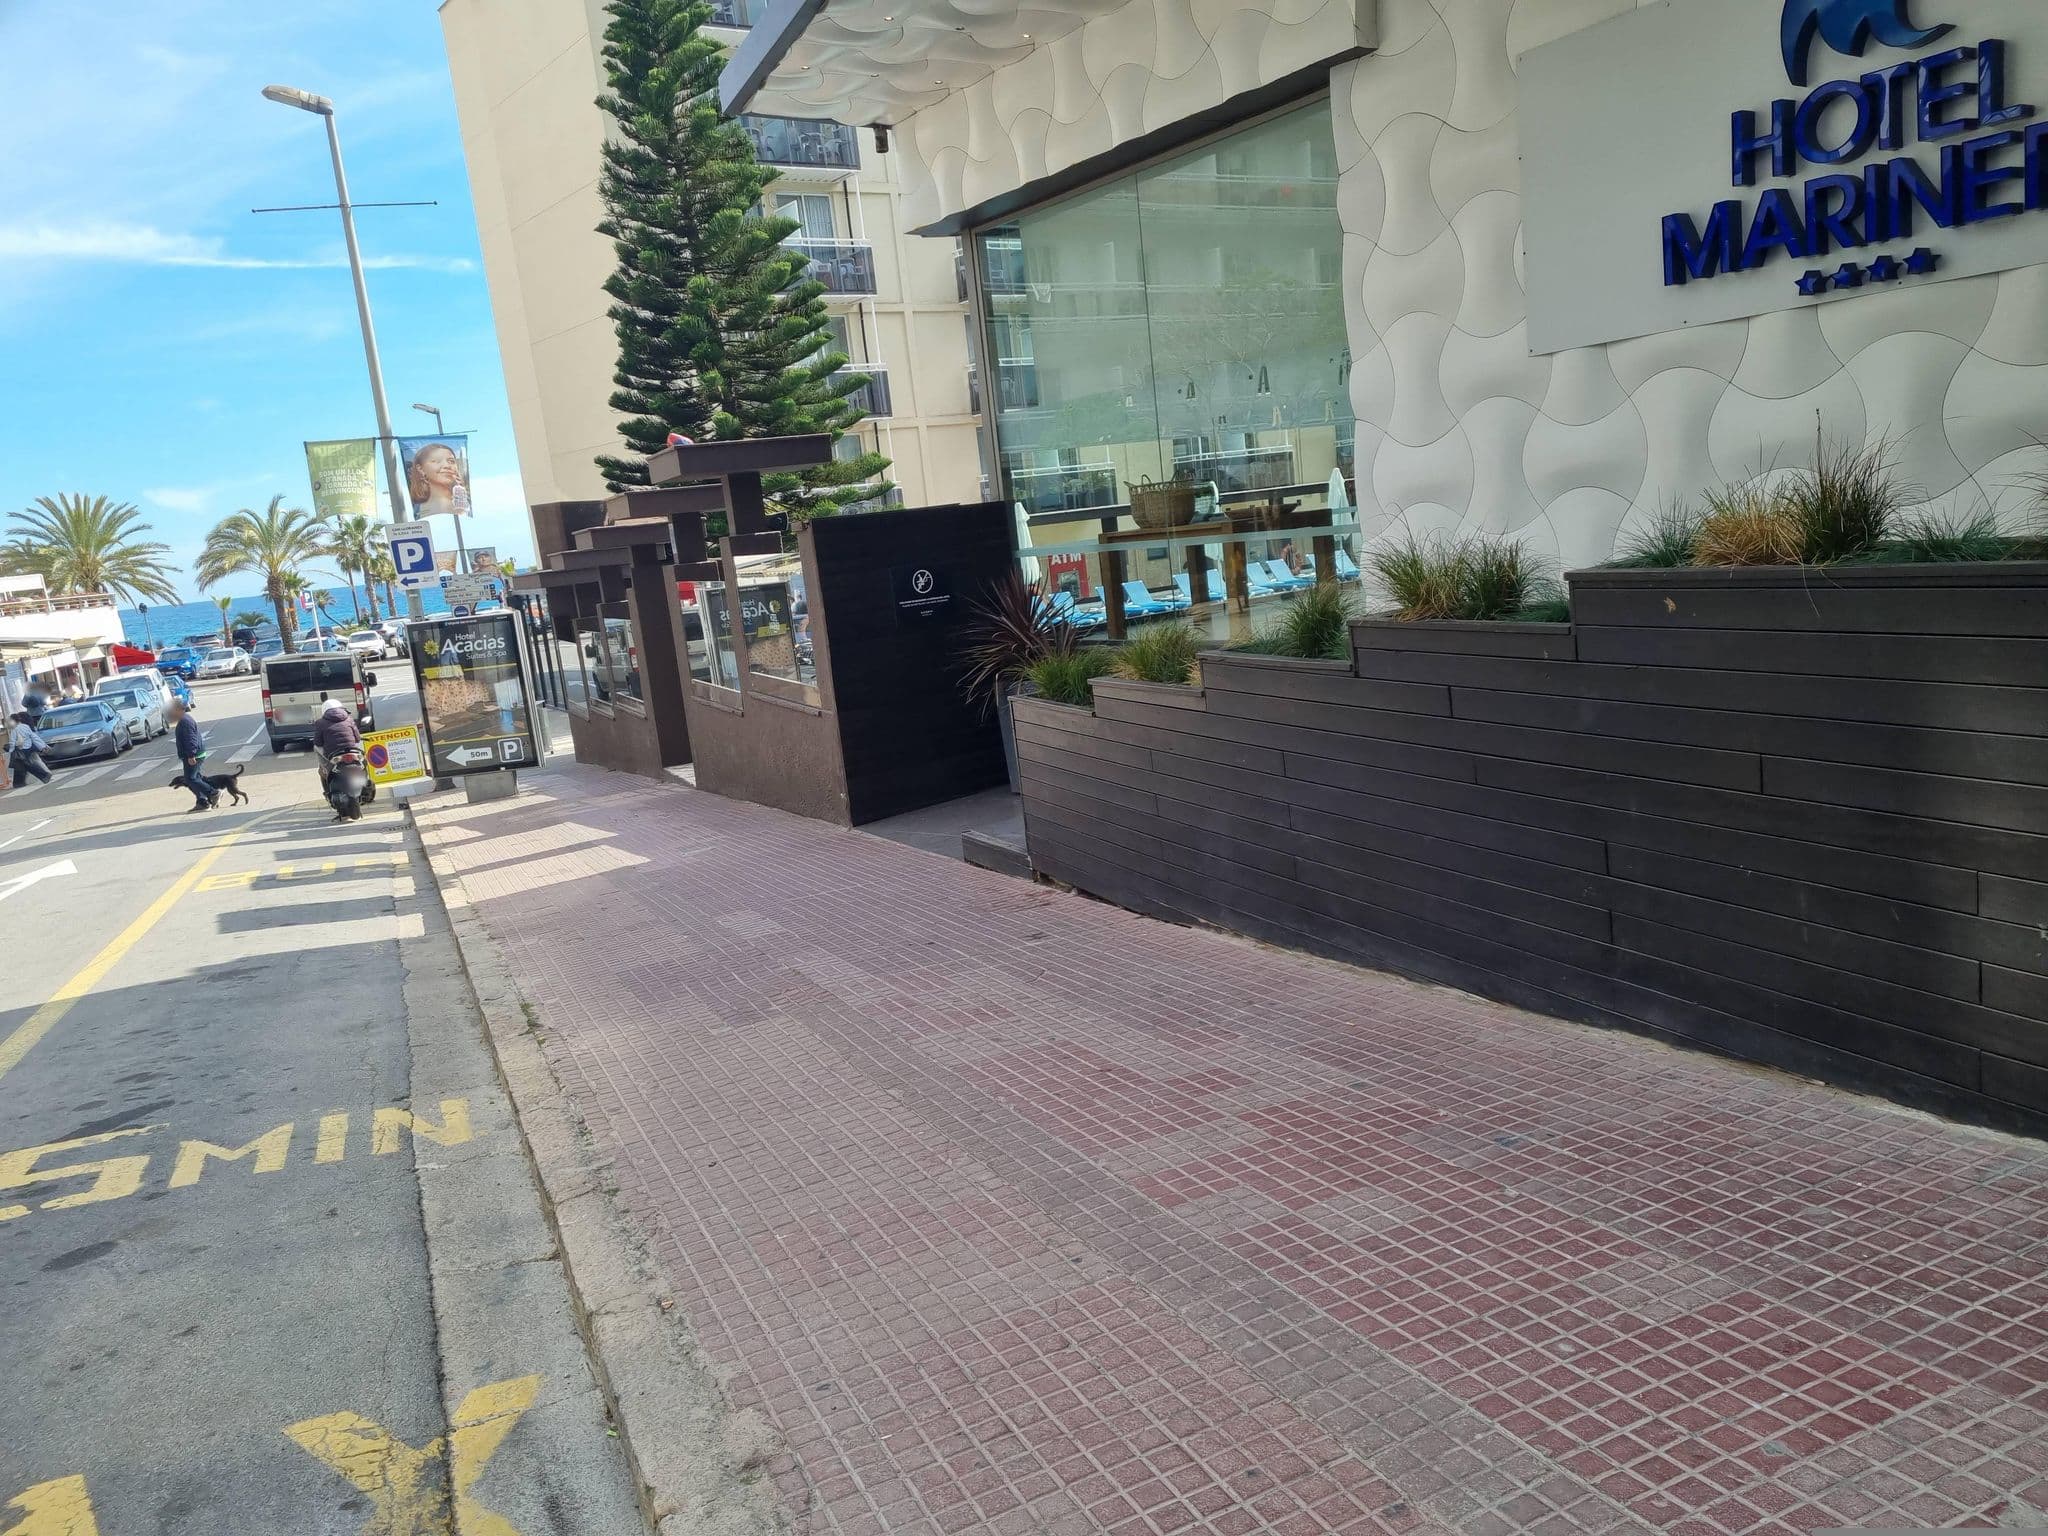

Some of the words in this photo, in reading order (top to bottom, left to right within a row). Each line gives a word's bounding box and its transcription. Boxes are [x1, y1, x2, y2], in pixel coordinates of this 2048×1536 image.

[1731, 39, 2035, 187] HOTEL
[397, 542, 424, 571] P
[1051, 553, 1082, 565] ATM
[455, 631, 476, 641] Hotel
[440, 634, 506, 655] Acacias
[494, 649, 507, 658] Spa
[370, 730, 411, 743] ATENCIÓ
[471, 750, 489, 758] 50m
[503, 741, 518, 760] P
